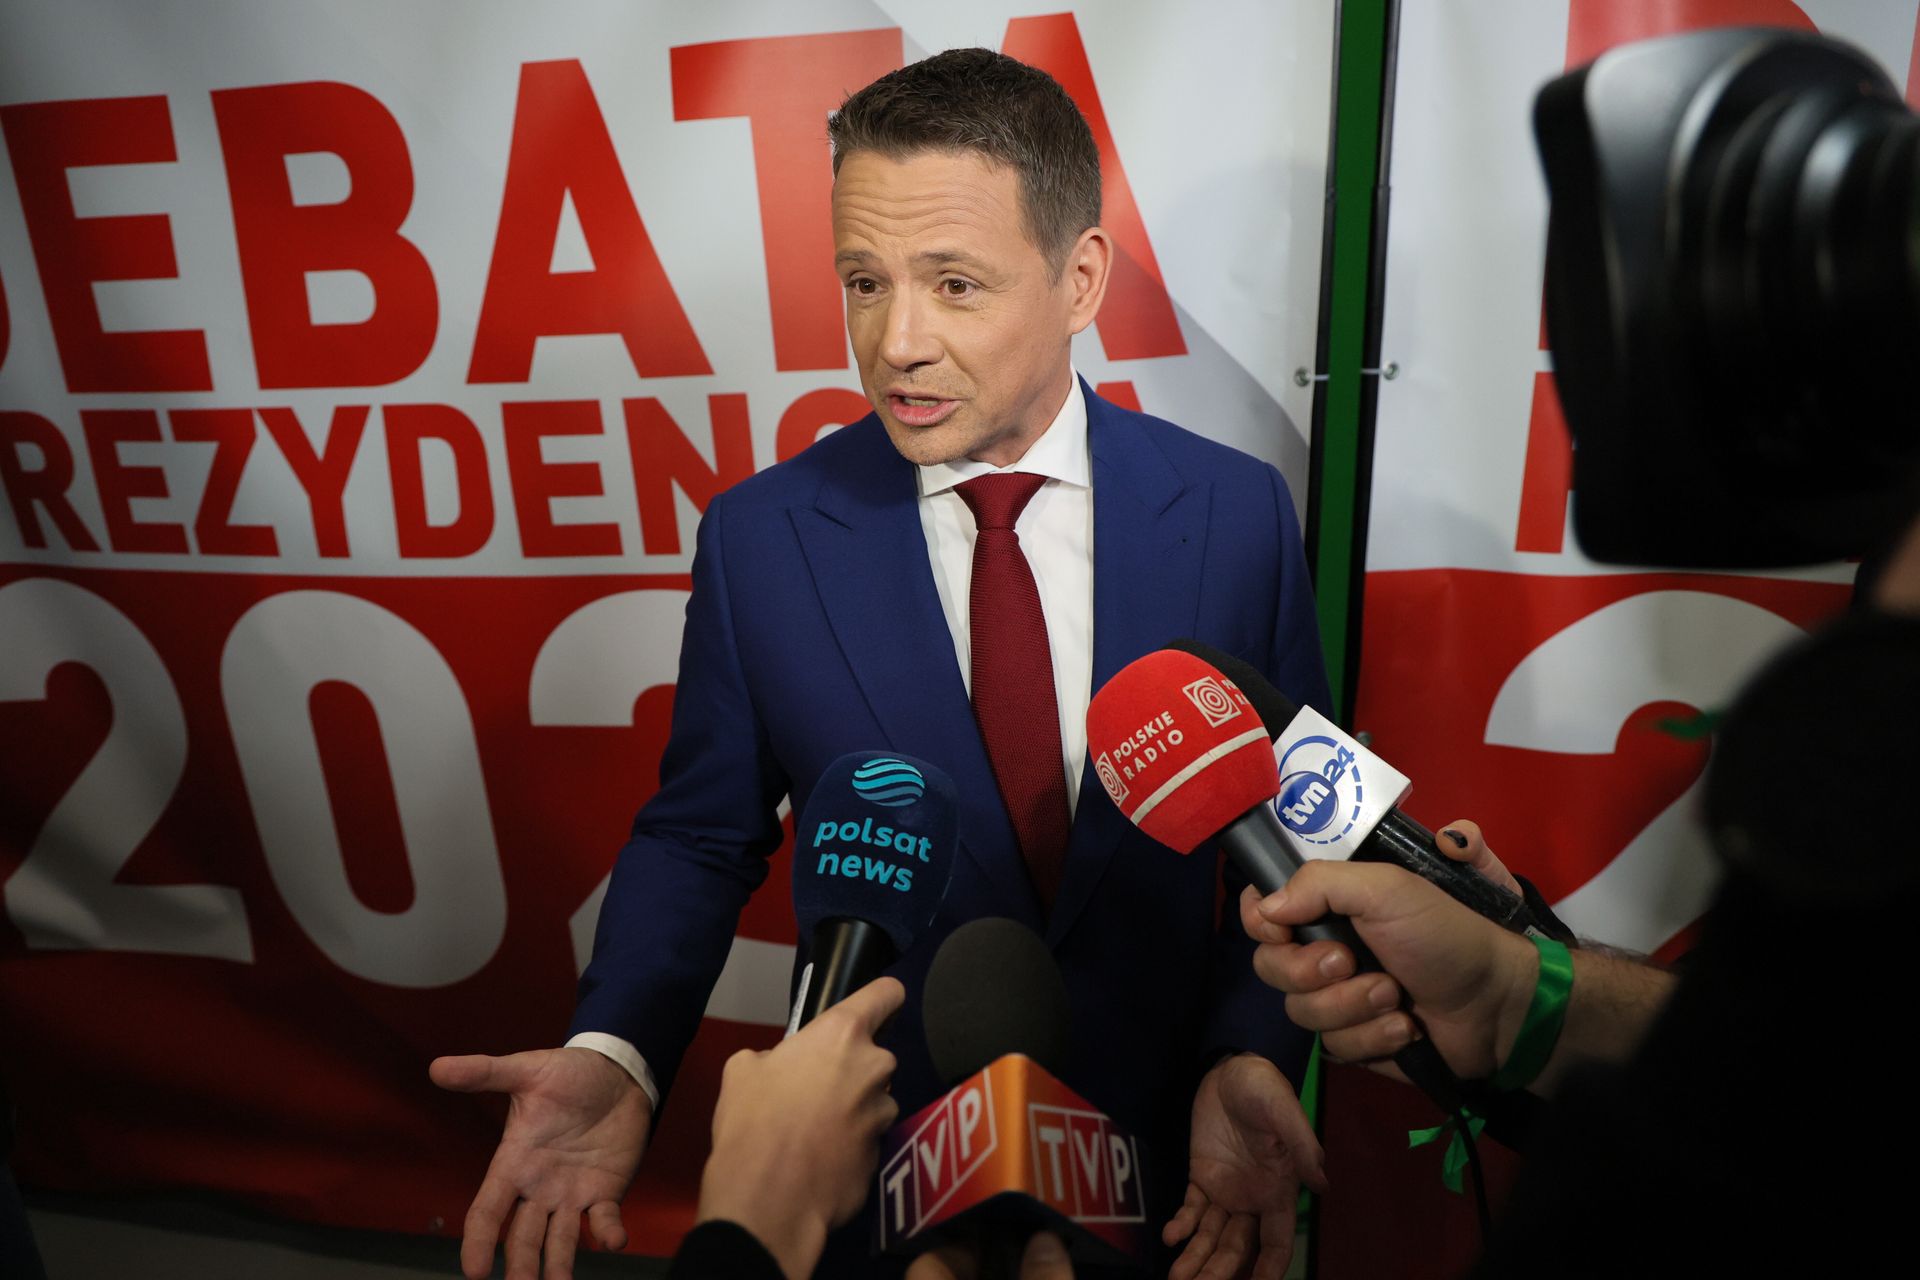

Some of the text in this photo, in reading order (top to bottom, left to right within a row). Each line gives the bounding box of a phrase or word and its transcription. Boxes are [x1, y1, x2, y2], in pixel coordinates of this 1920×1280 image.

[0, 11, 1189, 394] EBAT
[1113, 711, 1174, 763] POLSKIE
[1123, 729, 1184, 780] RADIO
[813, 817, 932, 862] polsat
[817, 852, 913, 892] news
[887, 1087, 982, 1233] TVP
[1039, 1126, 1131, 1204] TVP
